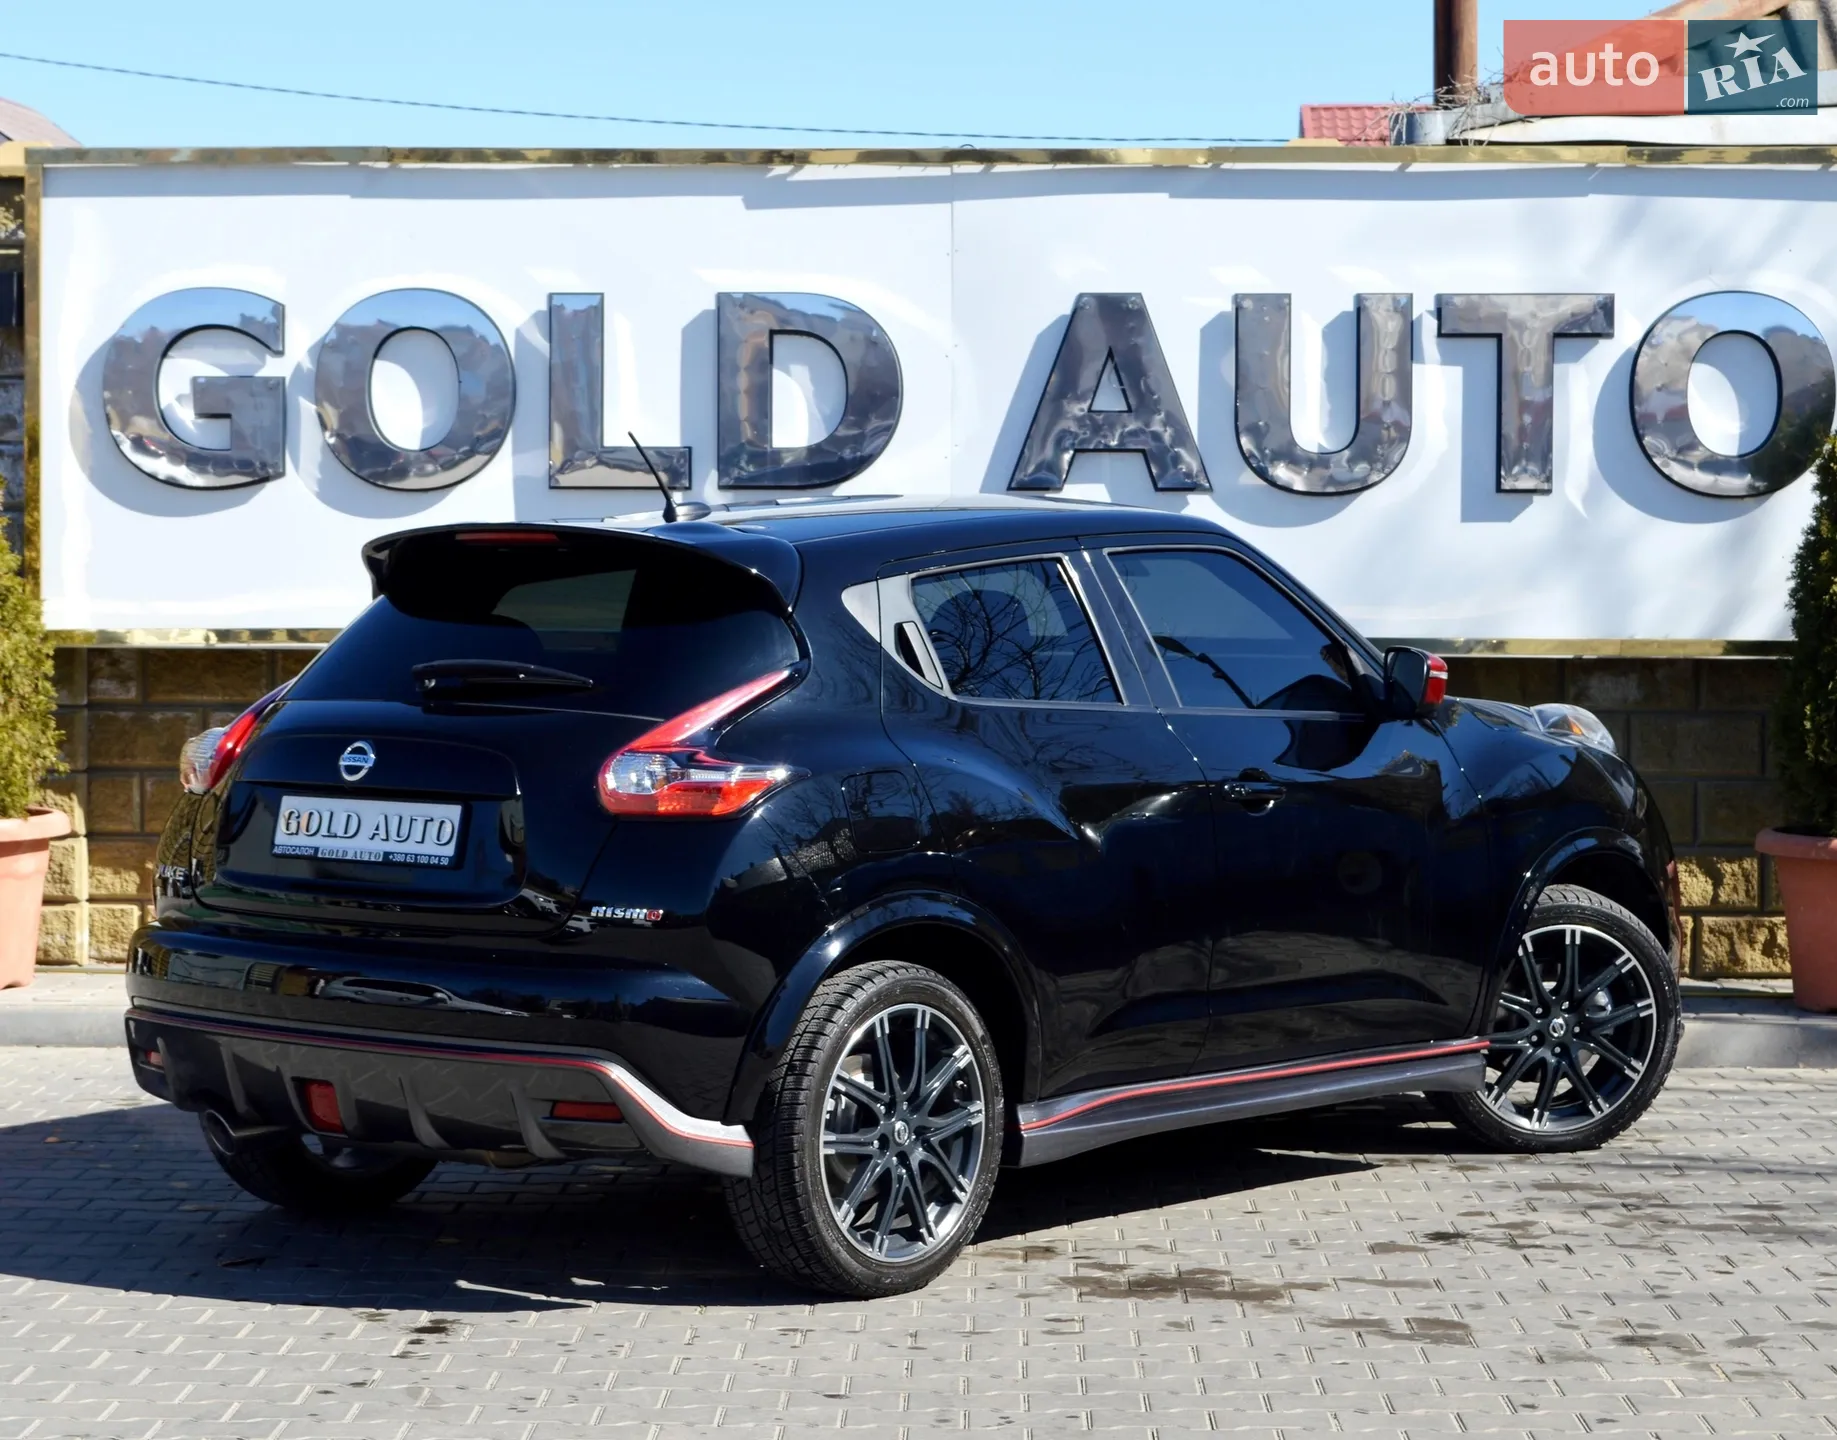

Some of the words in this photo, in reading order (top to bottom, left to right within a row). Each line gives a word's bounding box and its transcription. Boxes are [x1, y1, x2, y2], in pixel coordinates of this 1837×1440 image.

[102, 286, 904, 492] GOLD
[1007, 289, 1837, 500] AUTO
[280, 808, 361, 839] GOLD
[369, 814, 455, 846] AUTO
[320, 848, 349, 859] GOLD
[351, 849, 382, 861] AUTO
[388, 853, 406, 863] +380
[406, 854, 415, 864] 63
[416, 855, 429, 865] 100
